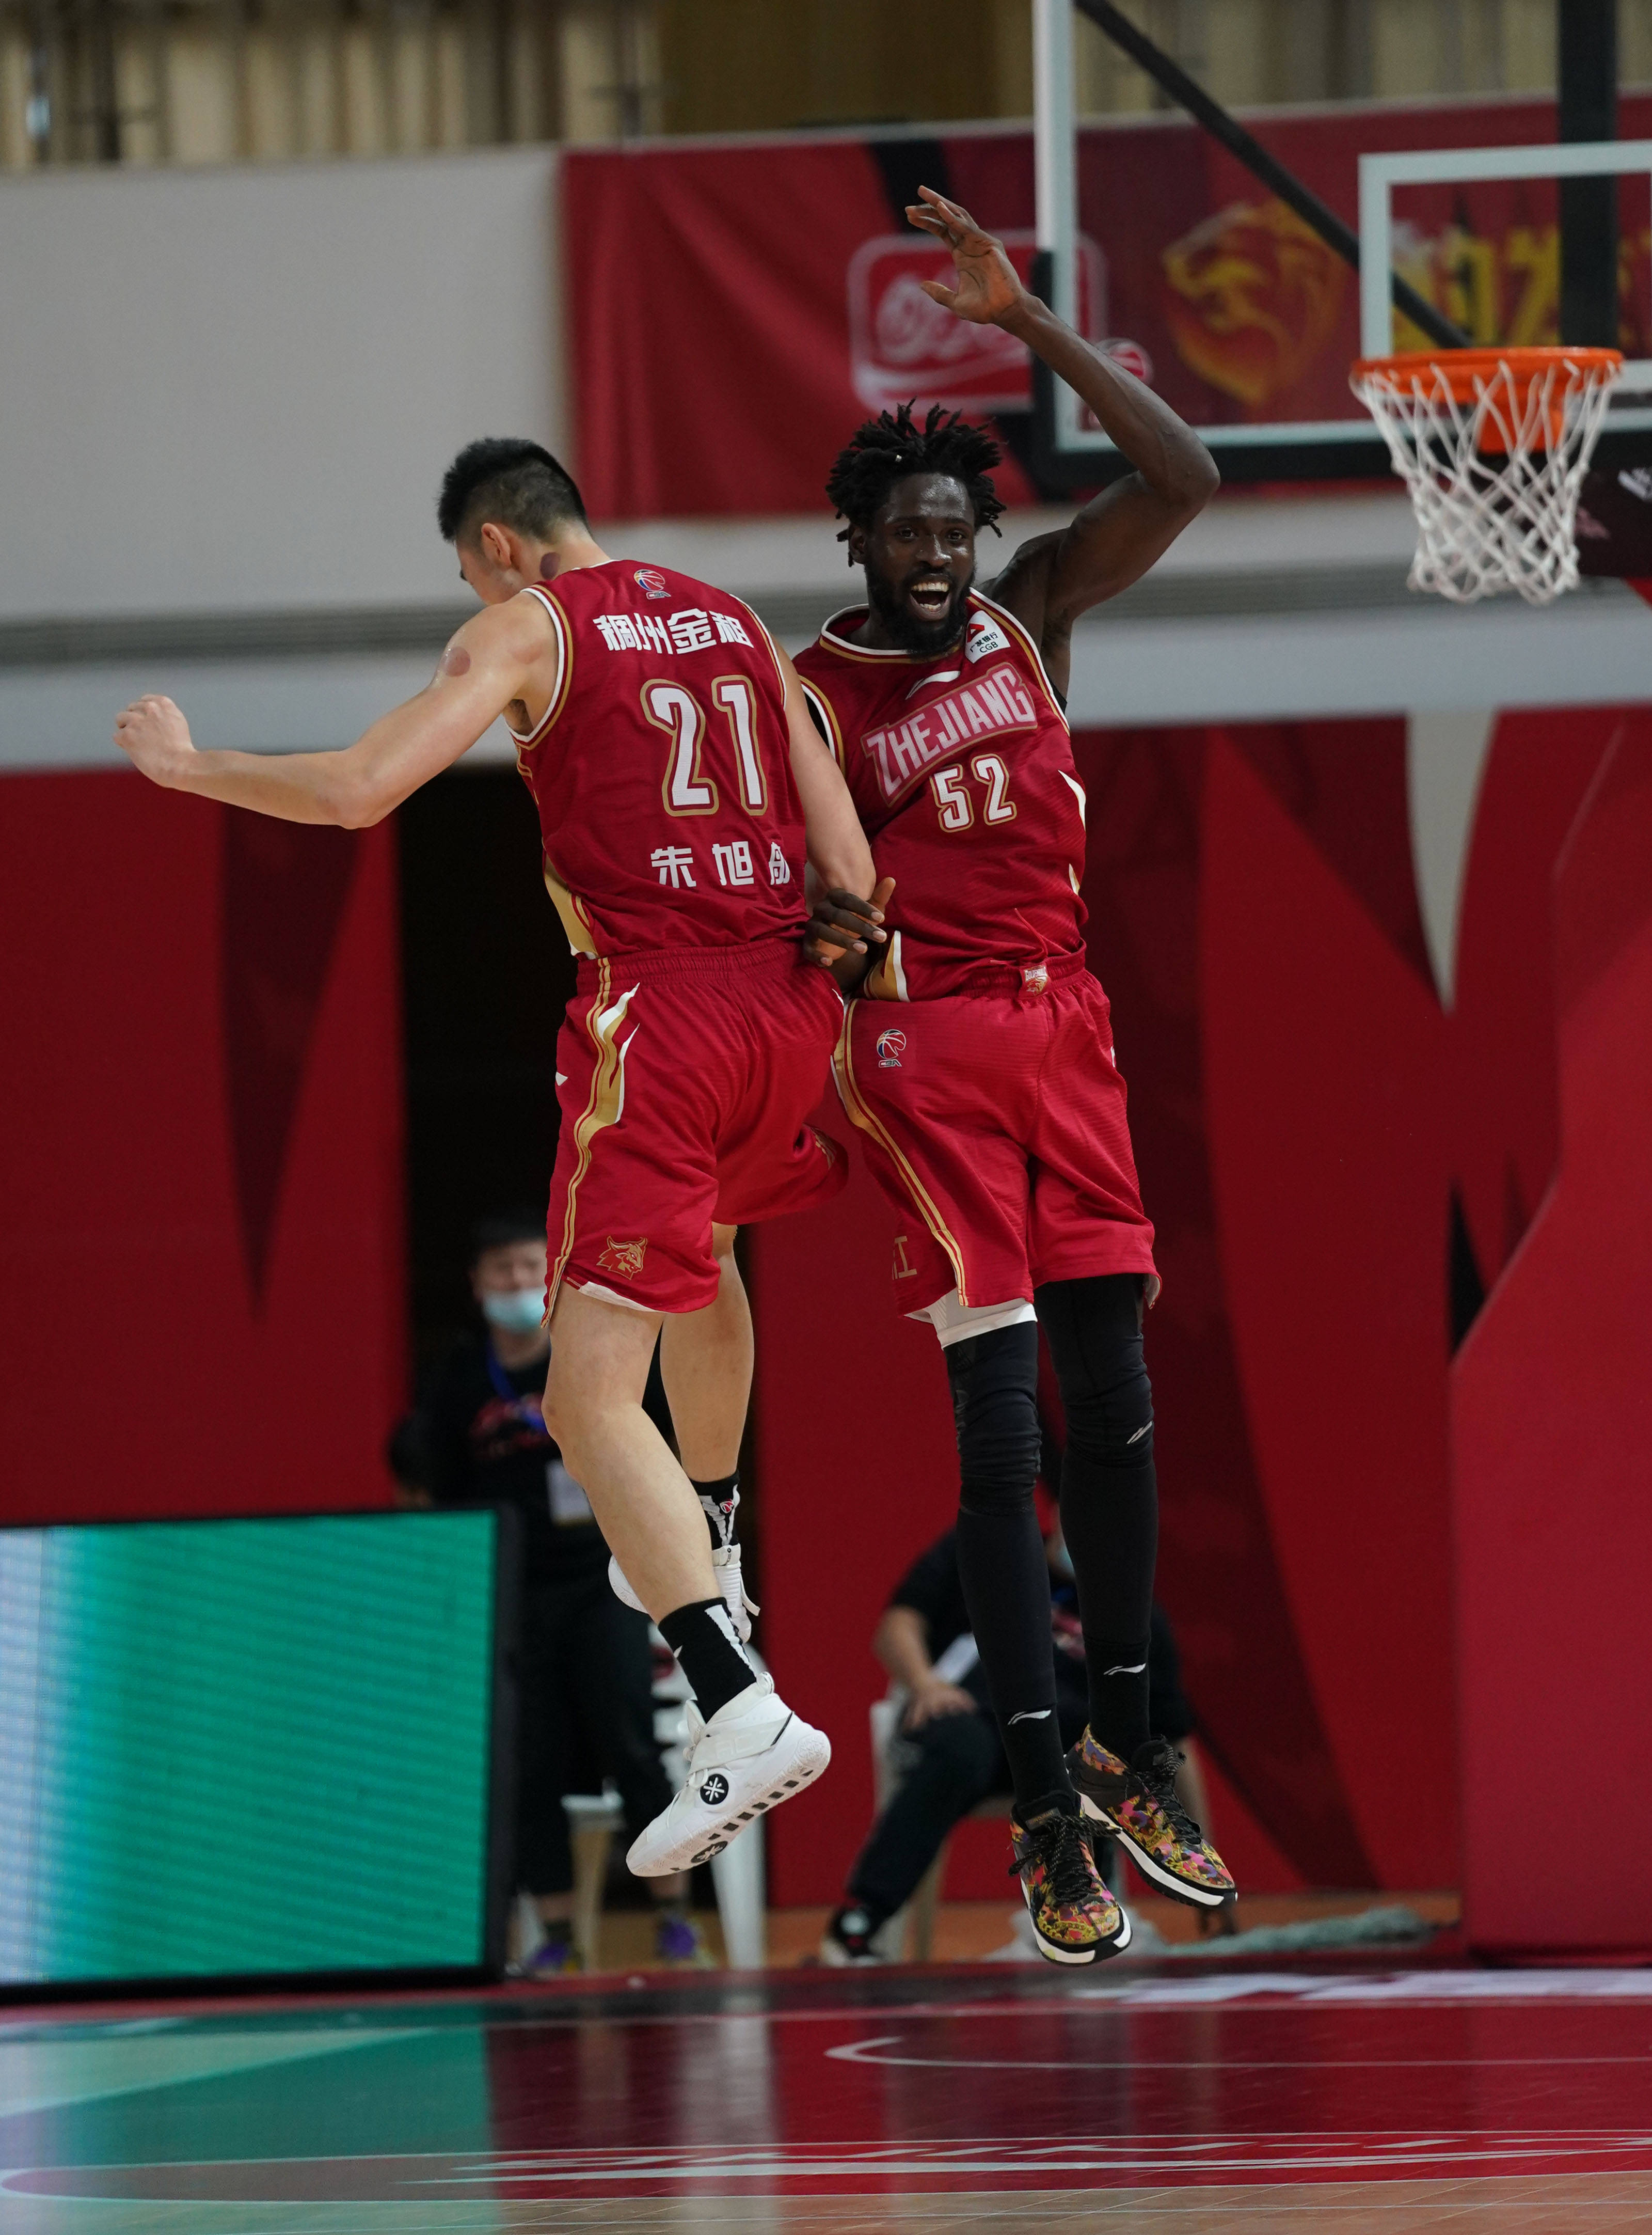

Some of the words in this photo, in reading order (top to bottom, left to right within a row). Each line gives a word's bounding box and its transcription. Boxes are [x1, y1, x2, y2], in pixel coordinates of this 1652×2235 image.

[593, 608, 754, 655] 稠州金租
[979, 641, 998, 653] CGB
[641, 676, 767, 815] 21
[866, 668, 1036, 797] ZHEJIANG
[931, 754, 1016, 832] 52
